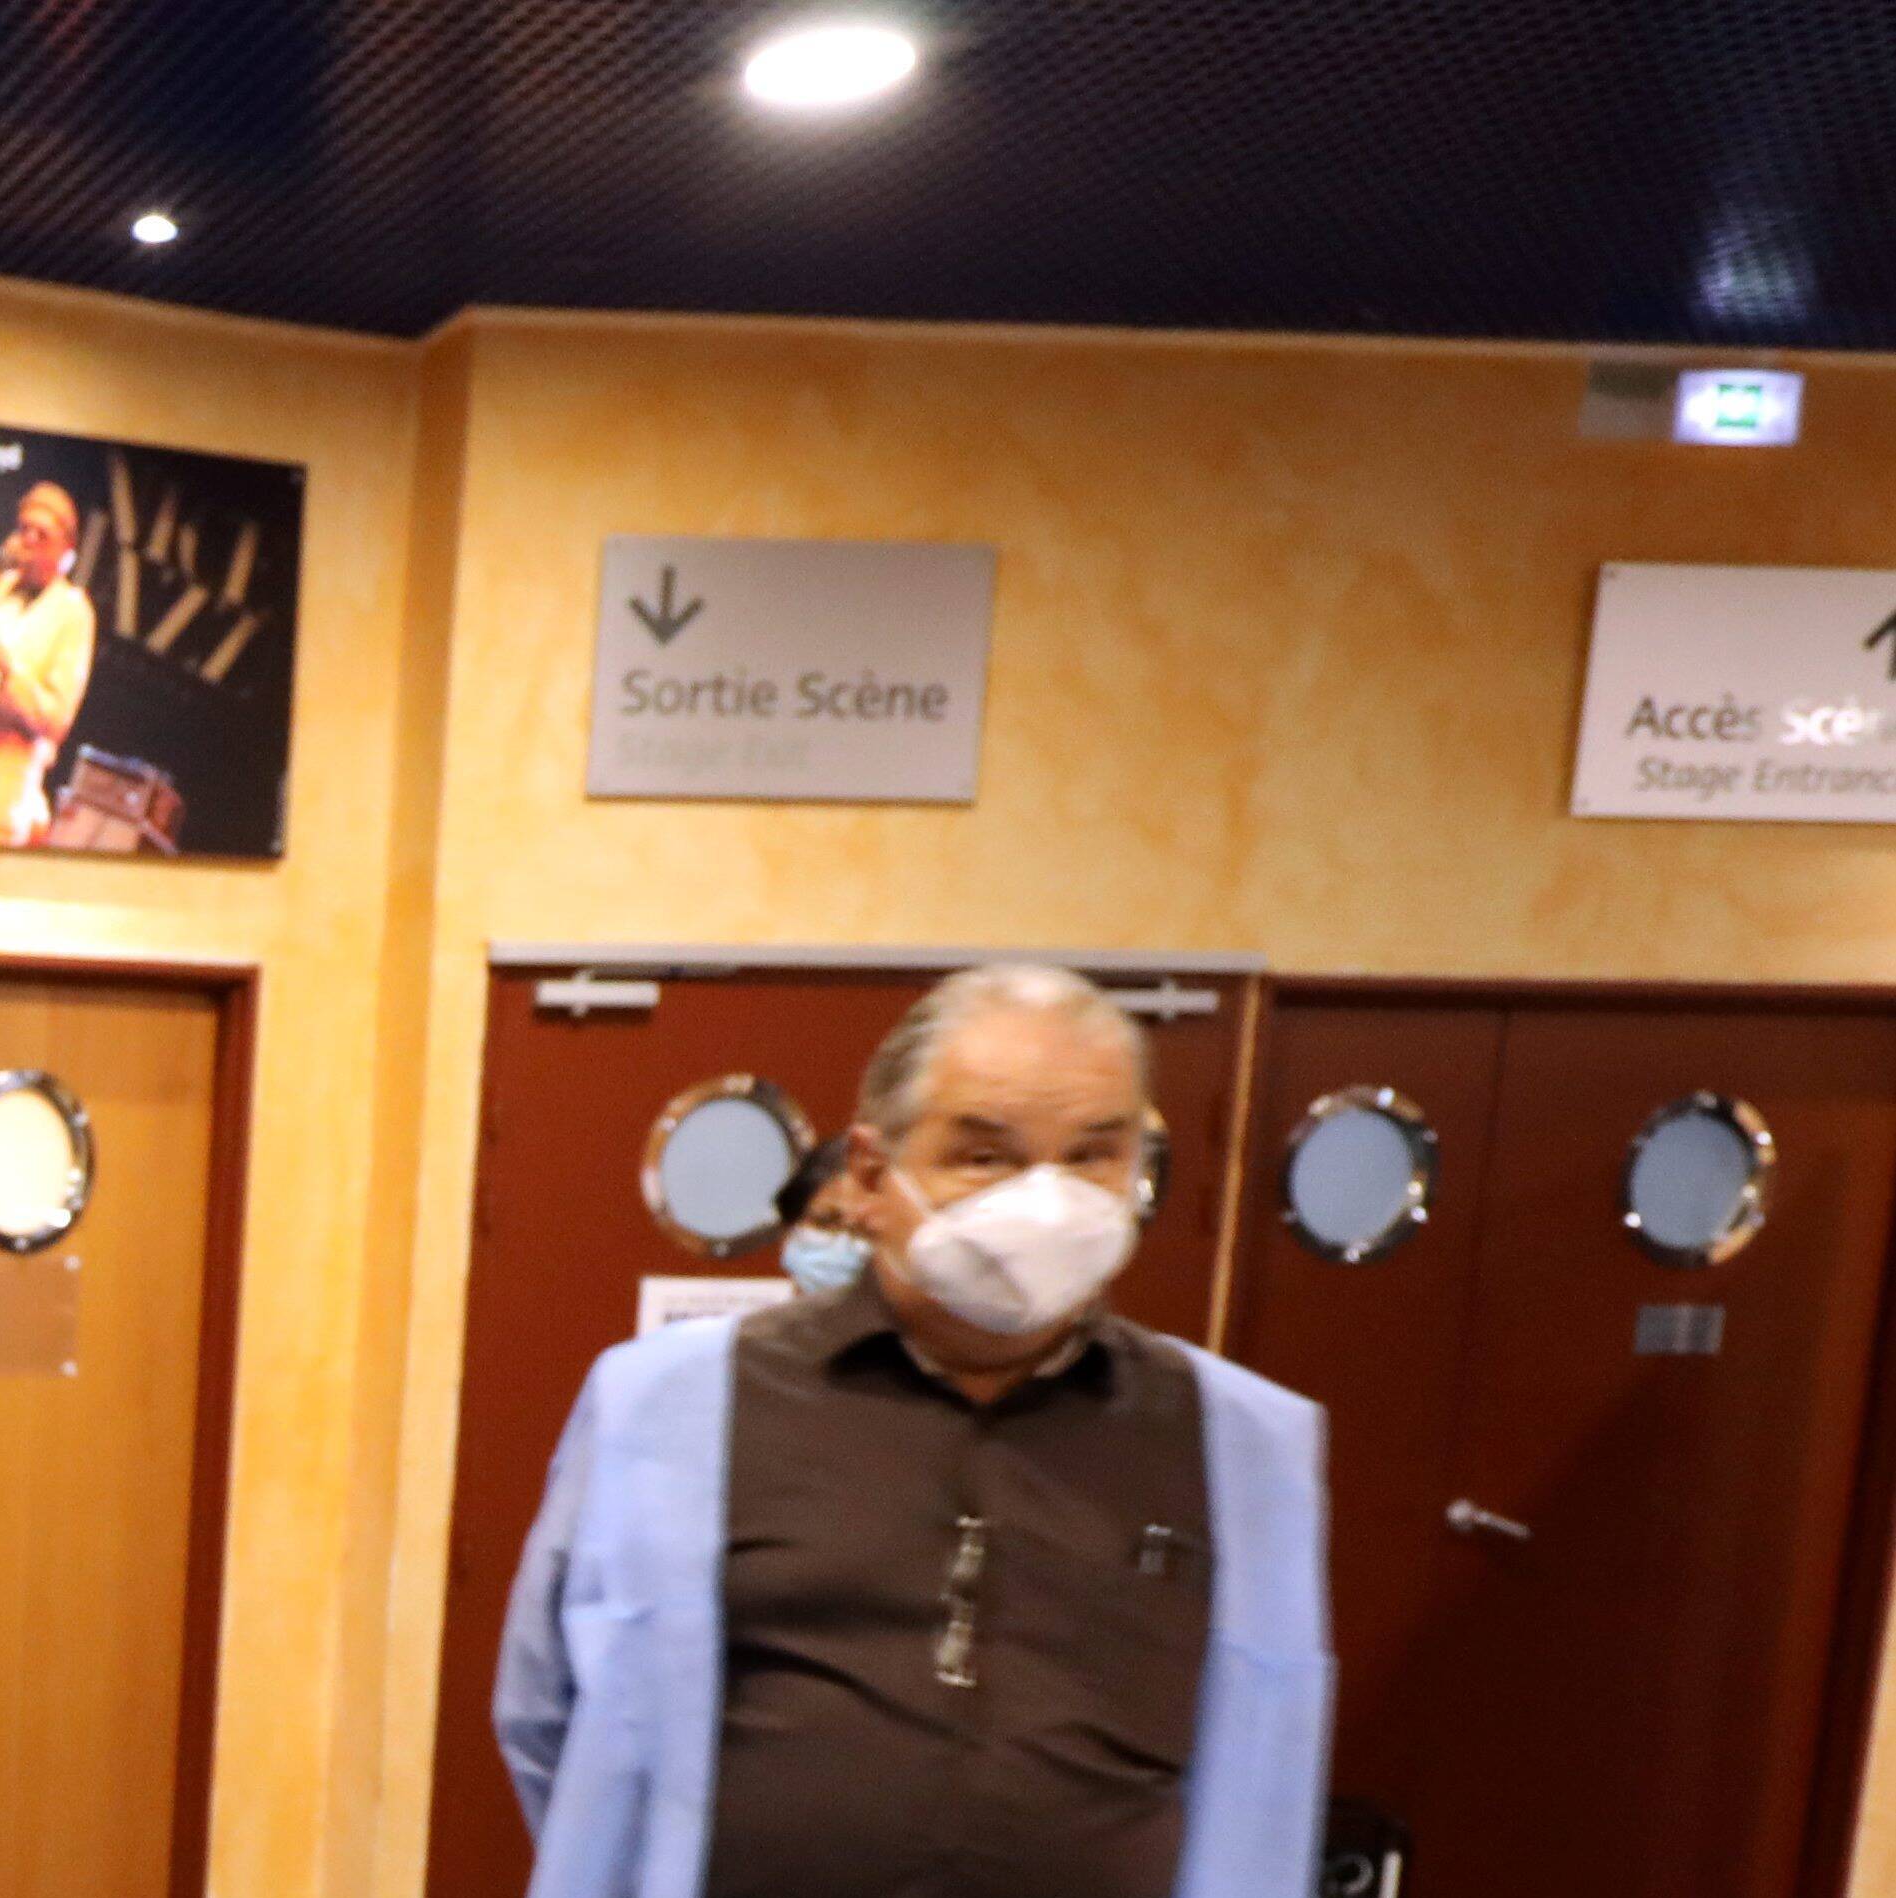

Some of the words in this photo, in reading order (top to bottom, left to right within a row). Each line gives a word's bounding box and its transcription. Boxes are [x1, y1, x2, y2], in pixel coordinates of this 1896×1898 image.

[620, 664, 778, 716] Sortie
[797, 668, 948, 721] Scène
[1624, 692, 1760, 741] Accès
[1635, 757, 1741, 801] Stage
